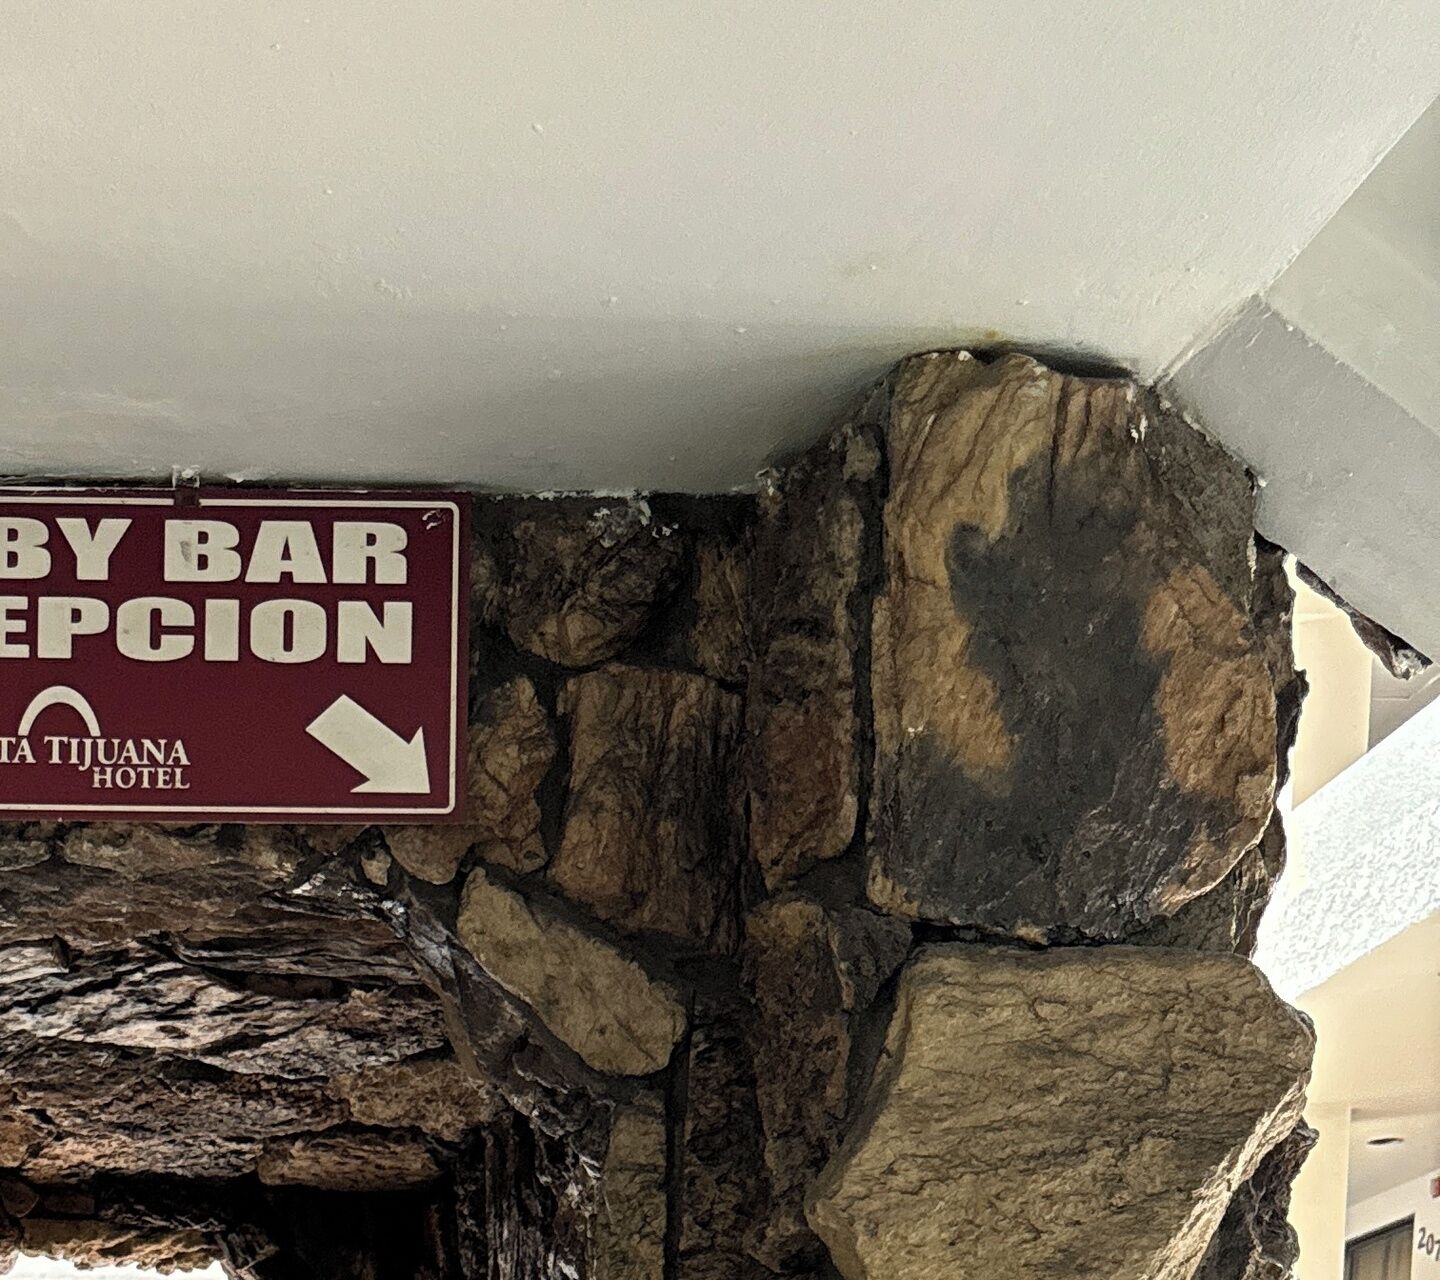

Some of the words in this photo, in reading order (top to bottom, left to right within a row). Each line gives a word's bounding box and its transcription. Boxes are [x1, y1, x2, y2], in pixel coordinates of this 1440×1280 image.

[163, 519, 408, 585] BAR
[43, 737, 191, 769] TIJUANA
[92, 766, 190, 790] HOTEL
